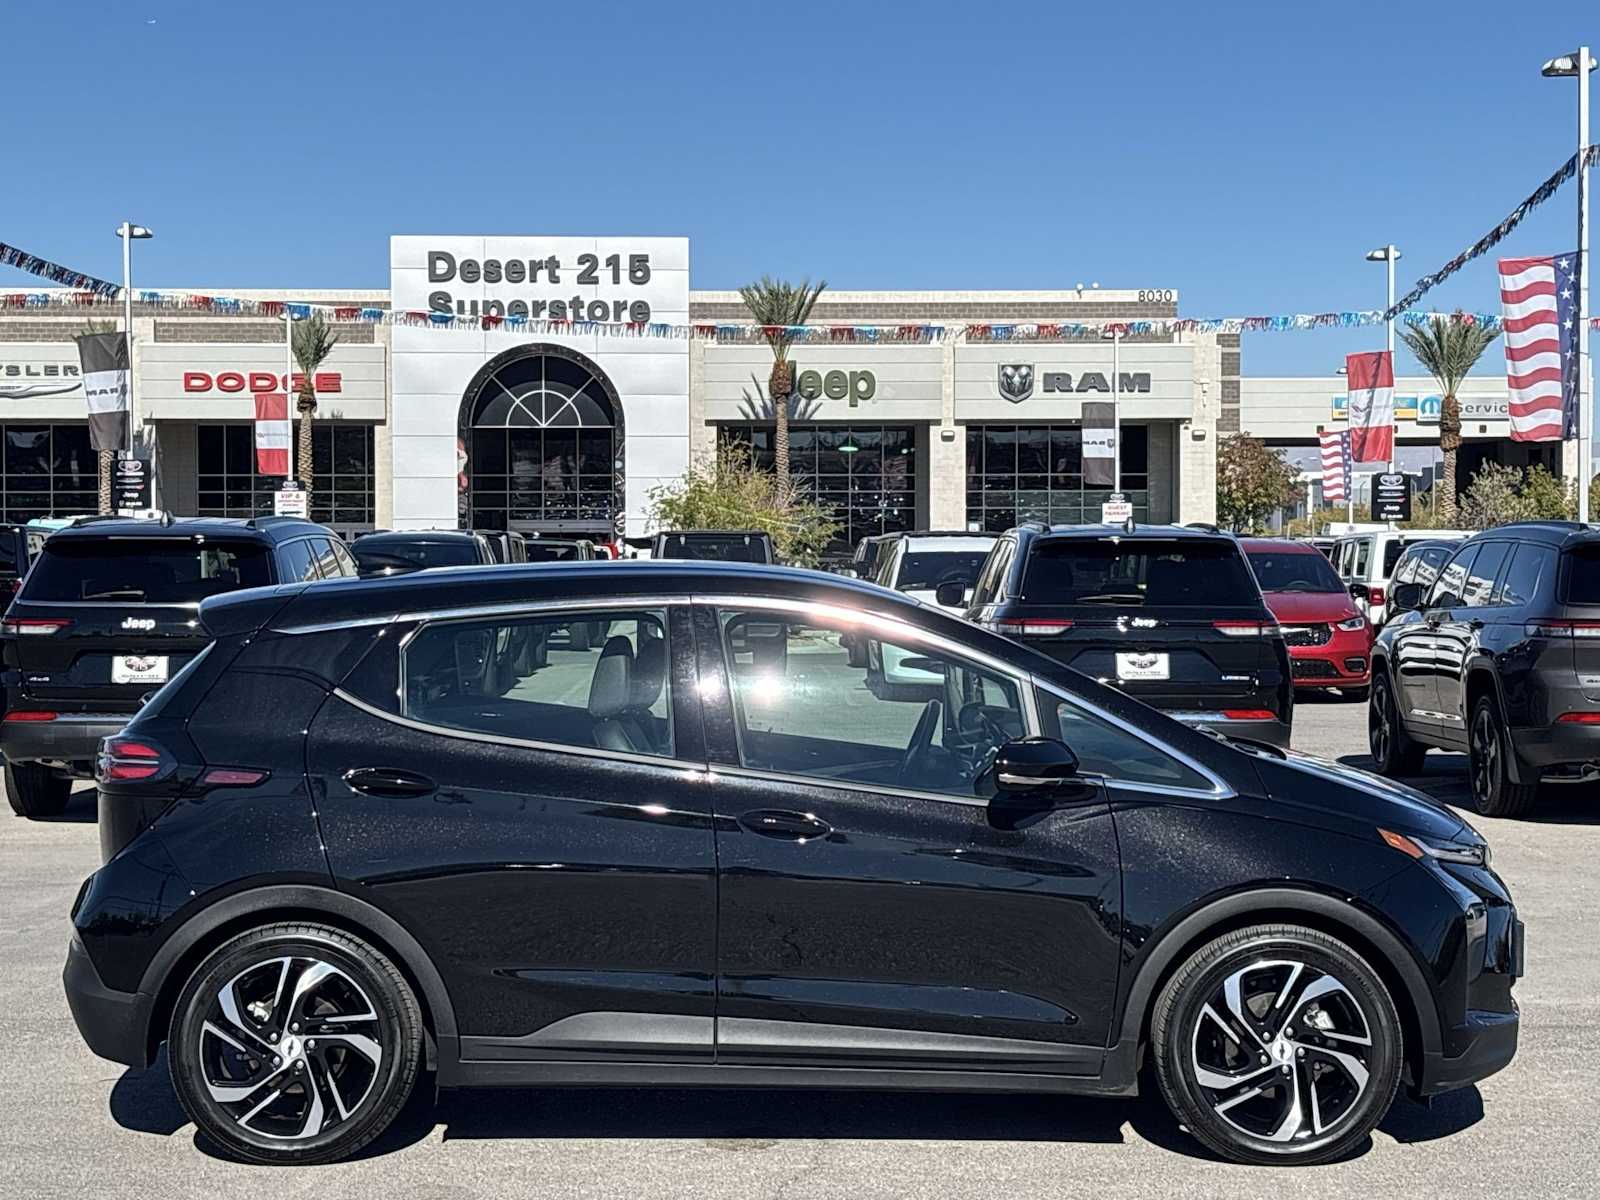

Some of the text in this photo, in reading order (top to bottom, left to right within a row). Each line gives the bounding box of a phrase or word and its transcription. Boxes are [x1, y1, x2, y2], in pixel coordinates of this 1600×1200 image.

[428, 250, 651, 286] Desert 215
[1138, 289, 1173, 303] 8030
[428, 290, 651, 331] Superstore
[0, 364, 80, 377] SLER
[184, 372, 342, 393] DODGE
[1043, 372, 1151, 393] RAM
[121, 616, 156, 631] Jeep
